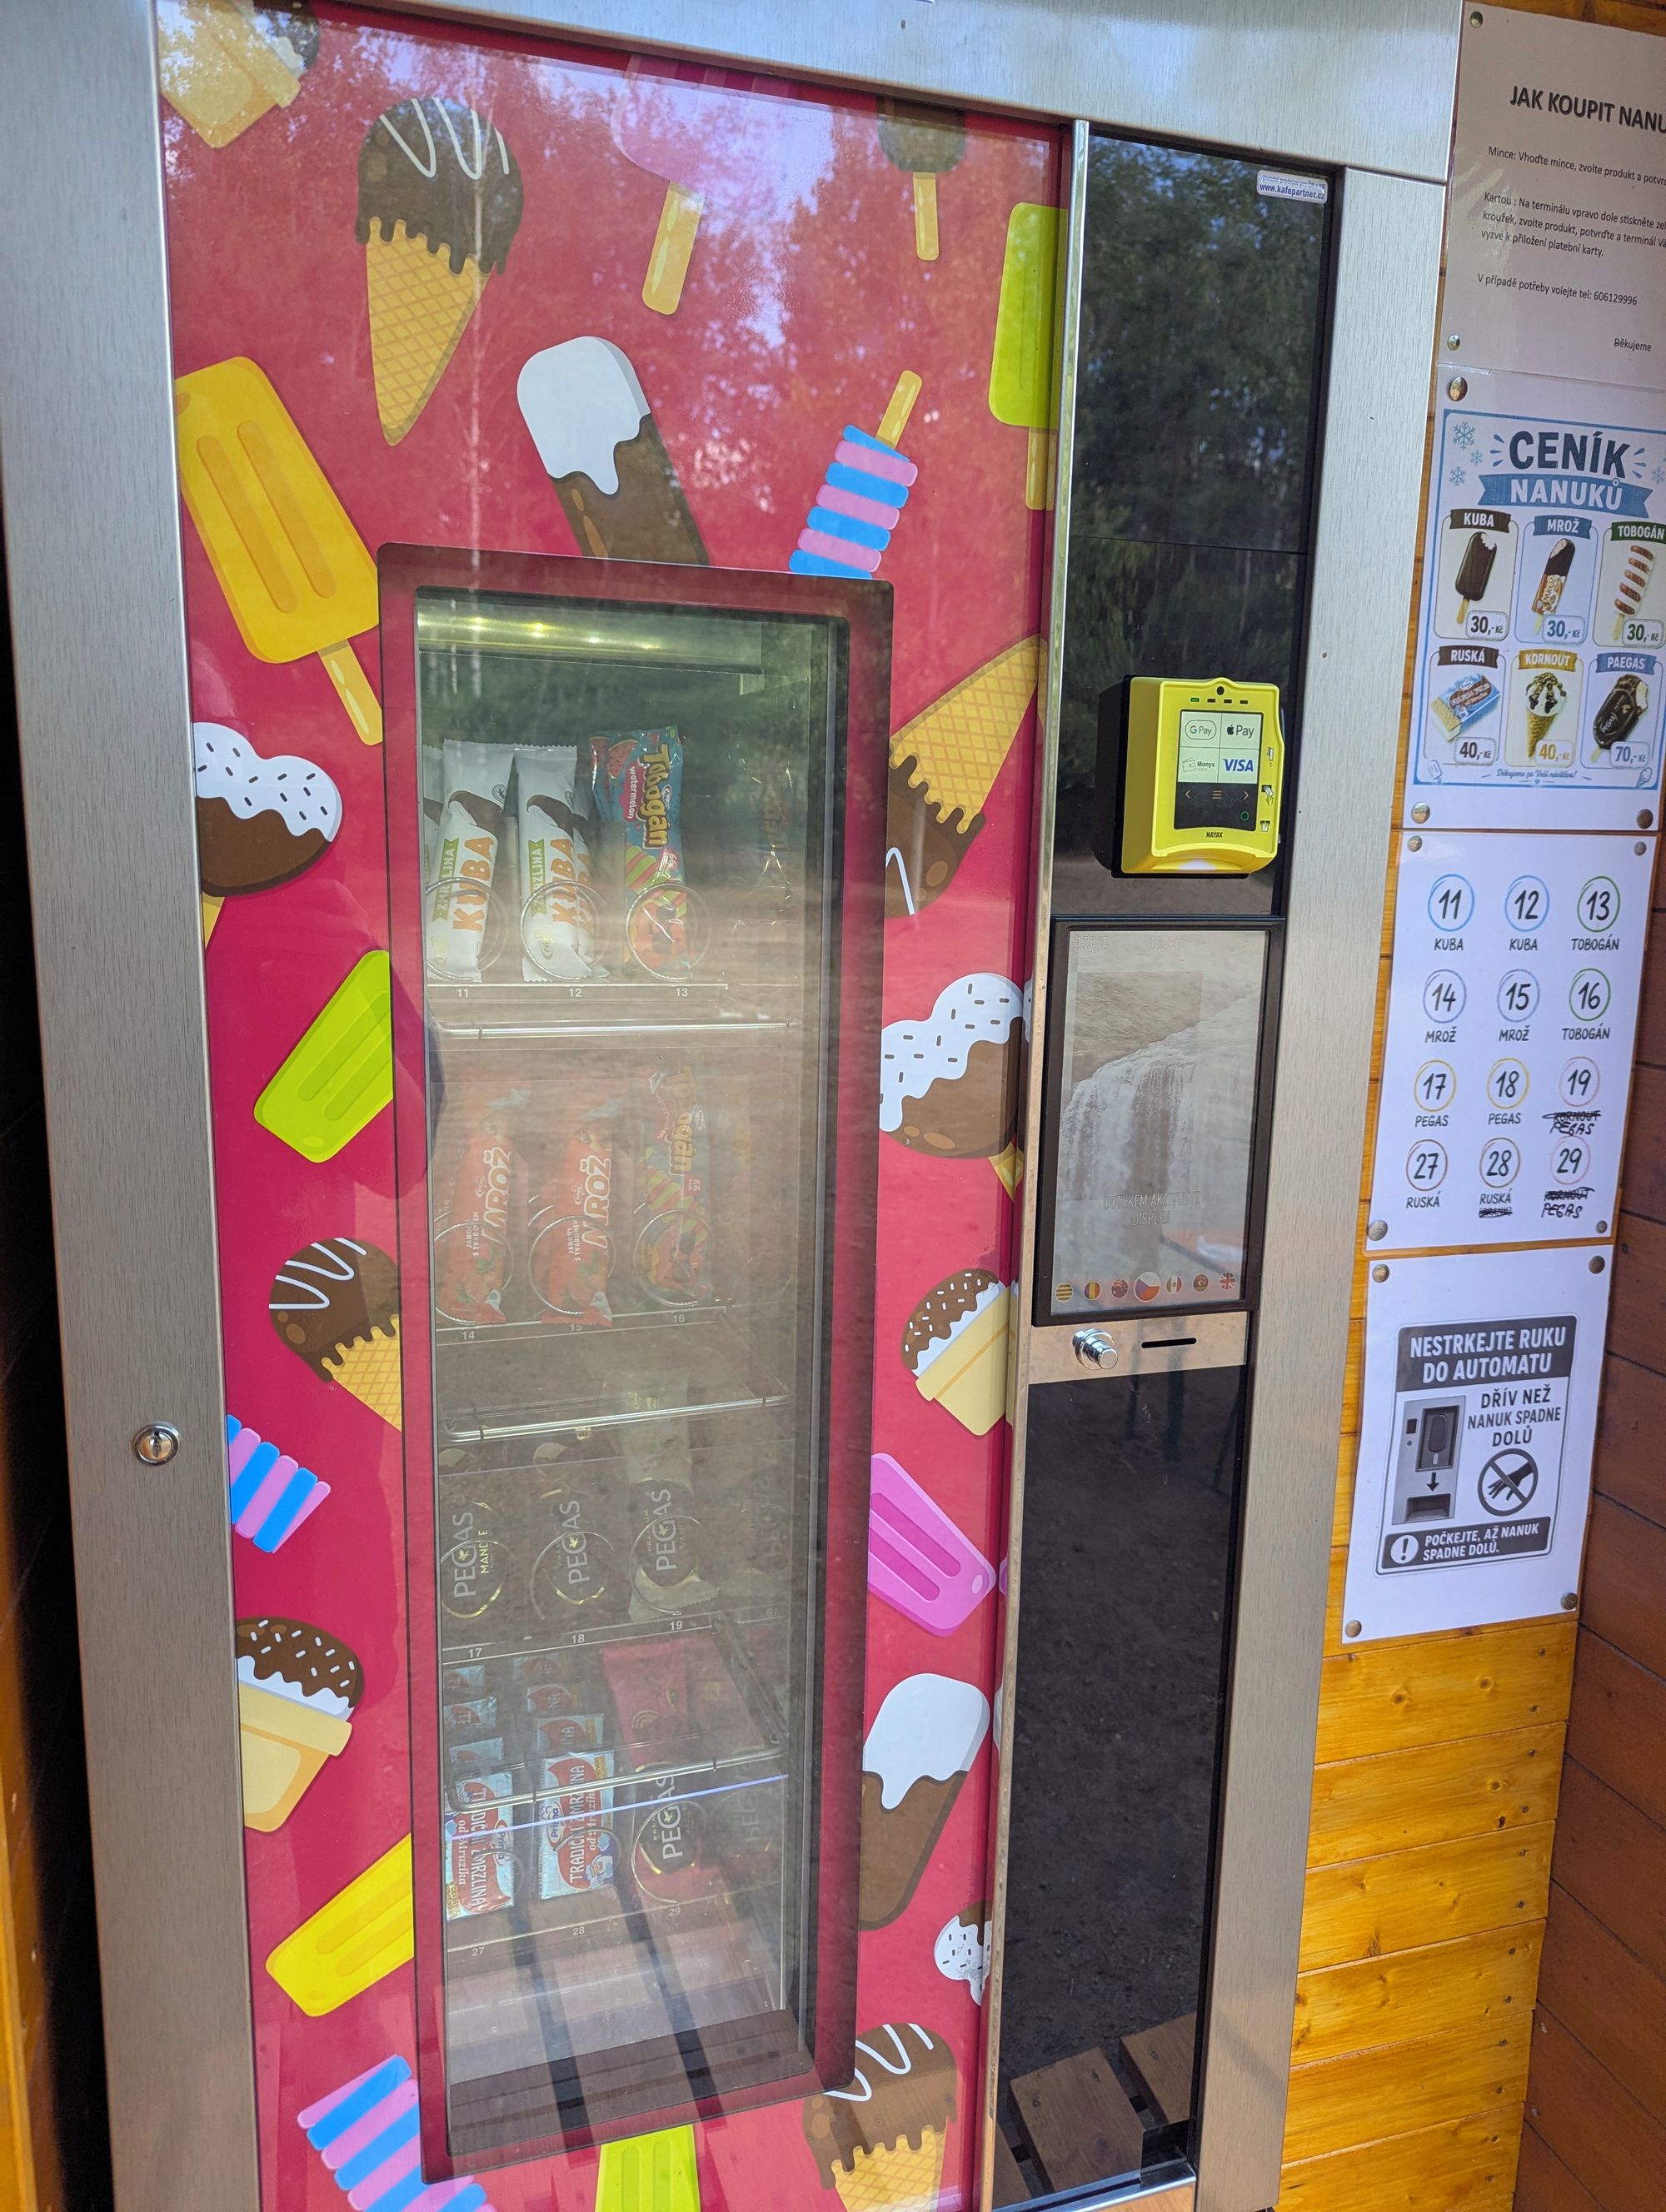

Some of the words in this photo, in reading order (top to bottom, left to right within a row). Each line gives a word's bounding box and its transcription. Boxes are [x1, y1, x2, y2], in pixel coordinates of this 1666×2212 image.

[1509, 85, 1544, 111] JAK
[1548, 92, 1615, 123] KOUPIT
[1488, 146, 1517, 160] Mince:
[1519, 151, 1549, 166] Vhoďte
[1550, 158, 1577, 172] mince,
[1579, 163, 1603, 175] zvolte
[1604, 165, 1635, 181] produkt
[1259, 183, 1325, 200] www.kafepartner.cz
[1484, 192, 1512, 205] Kartou
[1519, 197, 1530, 207] Na
[1532, 199, 1570, 215] terminálu
[1572, 207, 1599, 220] vpravo
[1600, 211, 1619, 223] dole
[1619, 214, 1654, 229] stiskněte
[1482, 210, 1517, 226] kroužek,
[1519, 217, 1543, 229] zvolte
[1544, 221, 1578, 237] produkt,
[1579, 227, 1615, 241] potvrďte
[1623, 233, 1657, 247] terminál
[1481, 230, 1504, 242] vyzve
[1505, 231, 1510, 242] k
[1513, 233, 1547, 247] přiložení
[1548, 238, 1581, 253] platební
[1582, 244, 1604, 257] karty.
[1477, 272, 1484, 282] V
[1485, 274, 1517, 288] případě
[1519, 279, 1549, 295] potřeby
[1551, 285, 1578, 299] volejte
[1579, 287, 1592, 300] tel:
[1594, 291, 1638, 306] 606129996
[1614, 337, 1652, 352] Děkujeme
[1509, 430, 1630, 479] CENÍK
[1510, 477, 1624, 511] NANUKŮ
[1463, 511, 1494, 528] KUBA
[1547, 517, 1579, 533] MROŽ
[1618, 523, 1664, 540] TOBOGÁN
[1450, 647, 1486, 664] RUSKÁ
[1524, 652, 1571, 667] KORNOUT
[1607, 655, 1646, 670] PAEGAS
[1199, 725, 1212, 736] Pay
[1235, 725, 1254, 739] Pay
[1197, 760, 1215, 769] Monyx
[1222, 759, 1254, 772] VISA
[627, 766, 637, 820] watermelon
[436, 848, 456, 912] ZMRLINA
[451, 835, 496, 934] KUBA
[1438, 889, 1462, 920] 11
[1514, 889, 1539, 920] 12
[1585, 890, 1610, 921] 13
[1434, 937, 1464, 951] KUBA
[1509, 937, 1538, 951] KUBA
[1571, 934, 1620, 951] TOBOGÁN
[456, 988, 469, 999] 11
[568, 988, 582, 999] 12
[675, 987, 689, 998] 13
[1431, 982, 1457, 1013] 14
[1505, 982, 1531, 1011] 15
[1577, 981, 1601, 1010] 16
[1424, 1025, 1458, 1044] MROŽ
[1499, 1024, 1530, 1042] MROŽ
[1562, 1022, 1610, 1040] TOBOGÁN
[1423, 1073, 1447, 1100] 17
[1495, 1070, 1519, 1098] 18
[1567, 1069, 1592, 1096] 19
[1414, 1114, 1449, 1128] PEGAS
[1488, 1113, 1522, 1125] PEGAS
[1413, 1152, 1439, 1180] 27
[1486, 1149, 1512, 1177] 28
[1556, 1147, 1582, 1174] 29
[1405, 1190, 1440, 1208] RUSKÁ
[1479, 1188, 1512, 1205] RUSKÁ
[1541, 1202, 1584, 1219] PEGAS
[672, 1314, 686, 1323] 16
[461, 1331, 475, 1340] 14
[1410, 1329, 1514, 1358] NESTRKEJTE
[1519, 1326, 1566, 1349] RUKU
[1423, 1361, 1448, 1383] DO
[1453, 1353, 1553, 1382] AUTOMATU
[1480, 1387, 1517, 1409] DŘÍV
[1522, 1383, 1551, 1404] NEŽ
[1467, 1409, 1513, 1430] NANUK
[1514, 1406, 1561, 1424] SPADNE
[1492, 1424, 1533, 1447] DOLŮ
[651, 1488, 677, 1571] PEGAS
[1424, 1529, 1480, 1547] POČKEJTE,
[1484, 1524, 1499, 1540] AŽ
[1500, 1522, 1539, 1538] NANUK
[451, 1511, 477, 1598] PEGAS
[477, 1529, 490, 1574] MANDE
[1422, 1545, 1466, 1562] SPADNE
[1468, 1537, 1499, 1557] DOLŮ.
[669, 1620, 683, 1631] 19
[571, 1633, 585, 1644] 18
[467, 1647, 483, 1659] 17
[668, 1906, 681, 1916] 29
[572, 1926, 585, 1936] 28
[471, 1945, 486, 1956] 27
